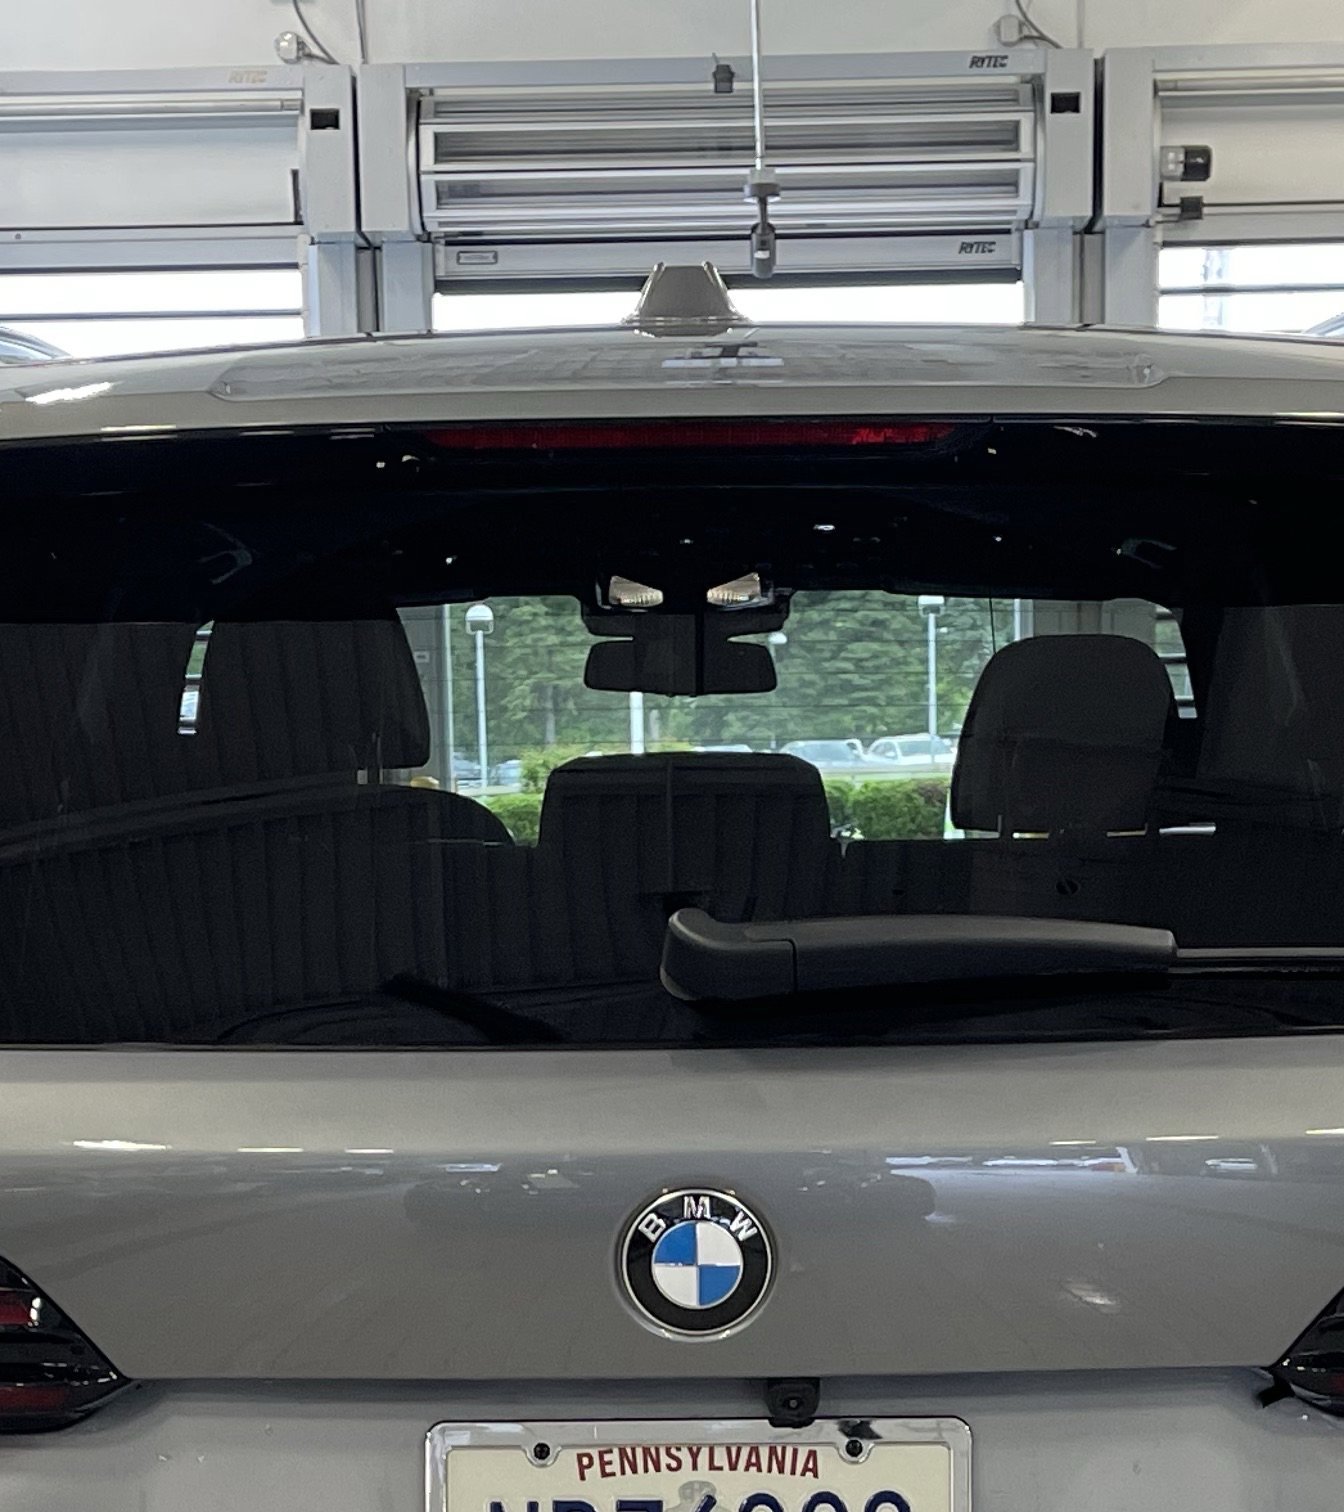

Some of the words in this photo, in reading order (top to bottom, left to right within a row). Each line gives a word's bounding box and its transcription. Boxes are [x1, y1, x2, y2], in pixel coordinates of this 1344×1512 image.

[969, 55, 1009, 69] RYTEC
[958, 241, 996, 255] RYTEC
[638, 1195, 758, 1243] BMW
[576, 1446, 819, 1482] PENNSYLVANIA
